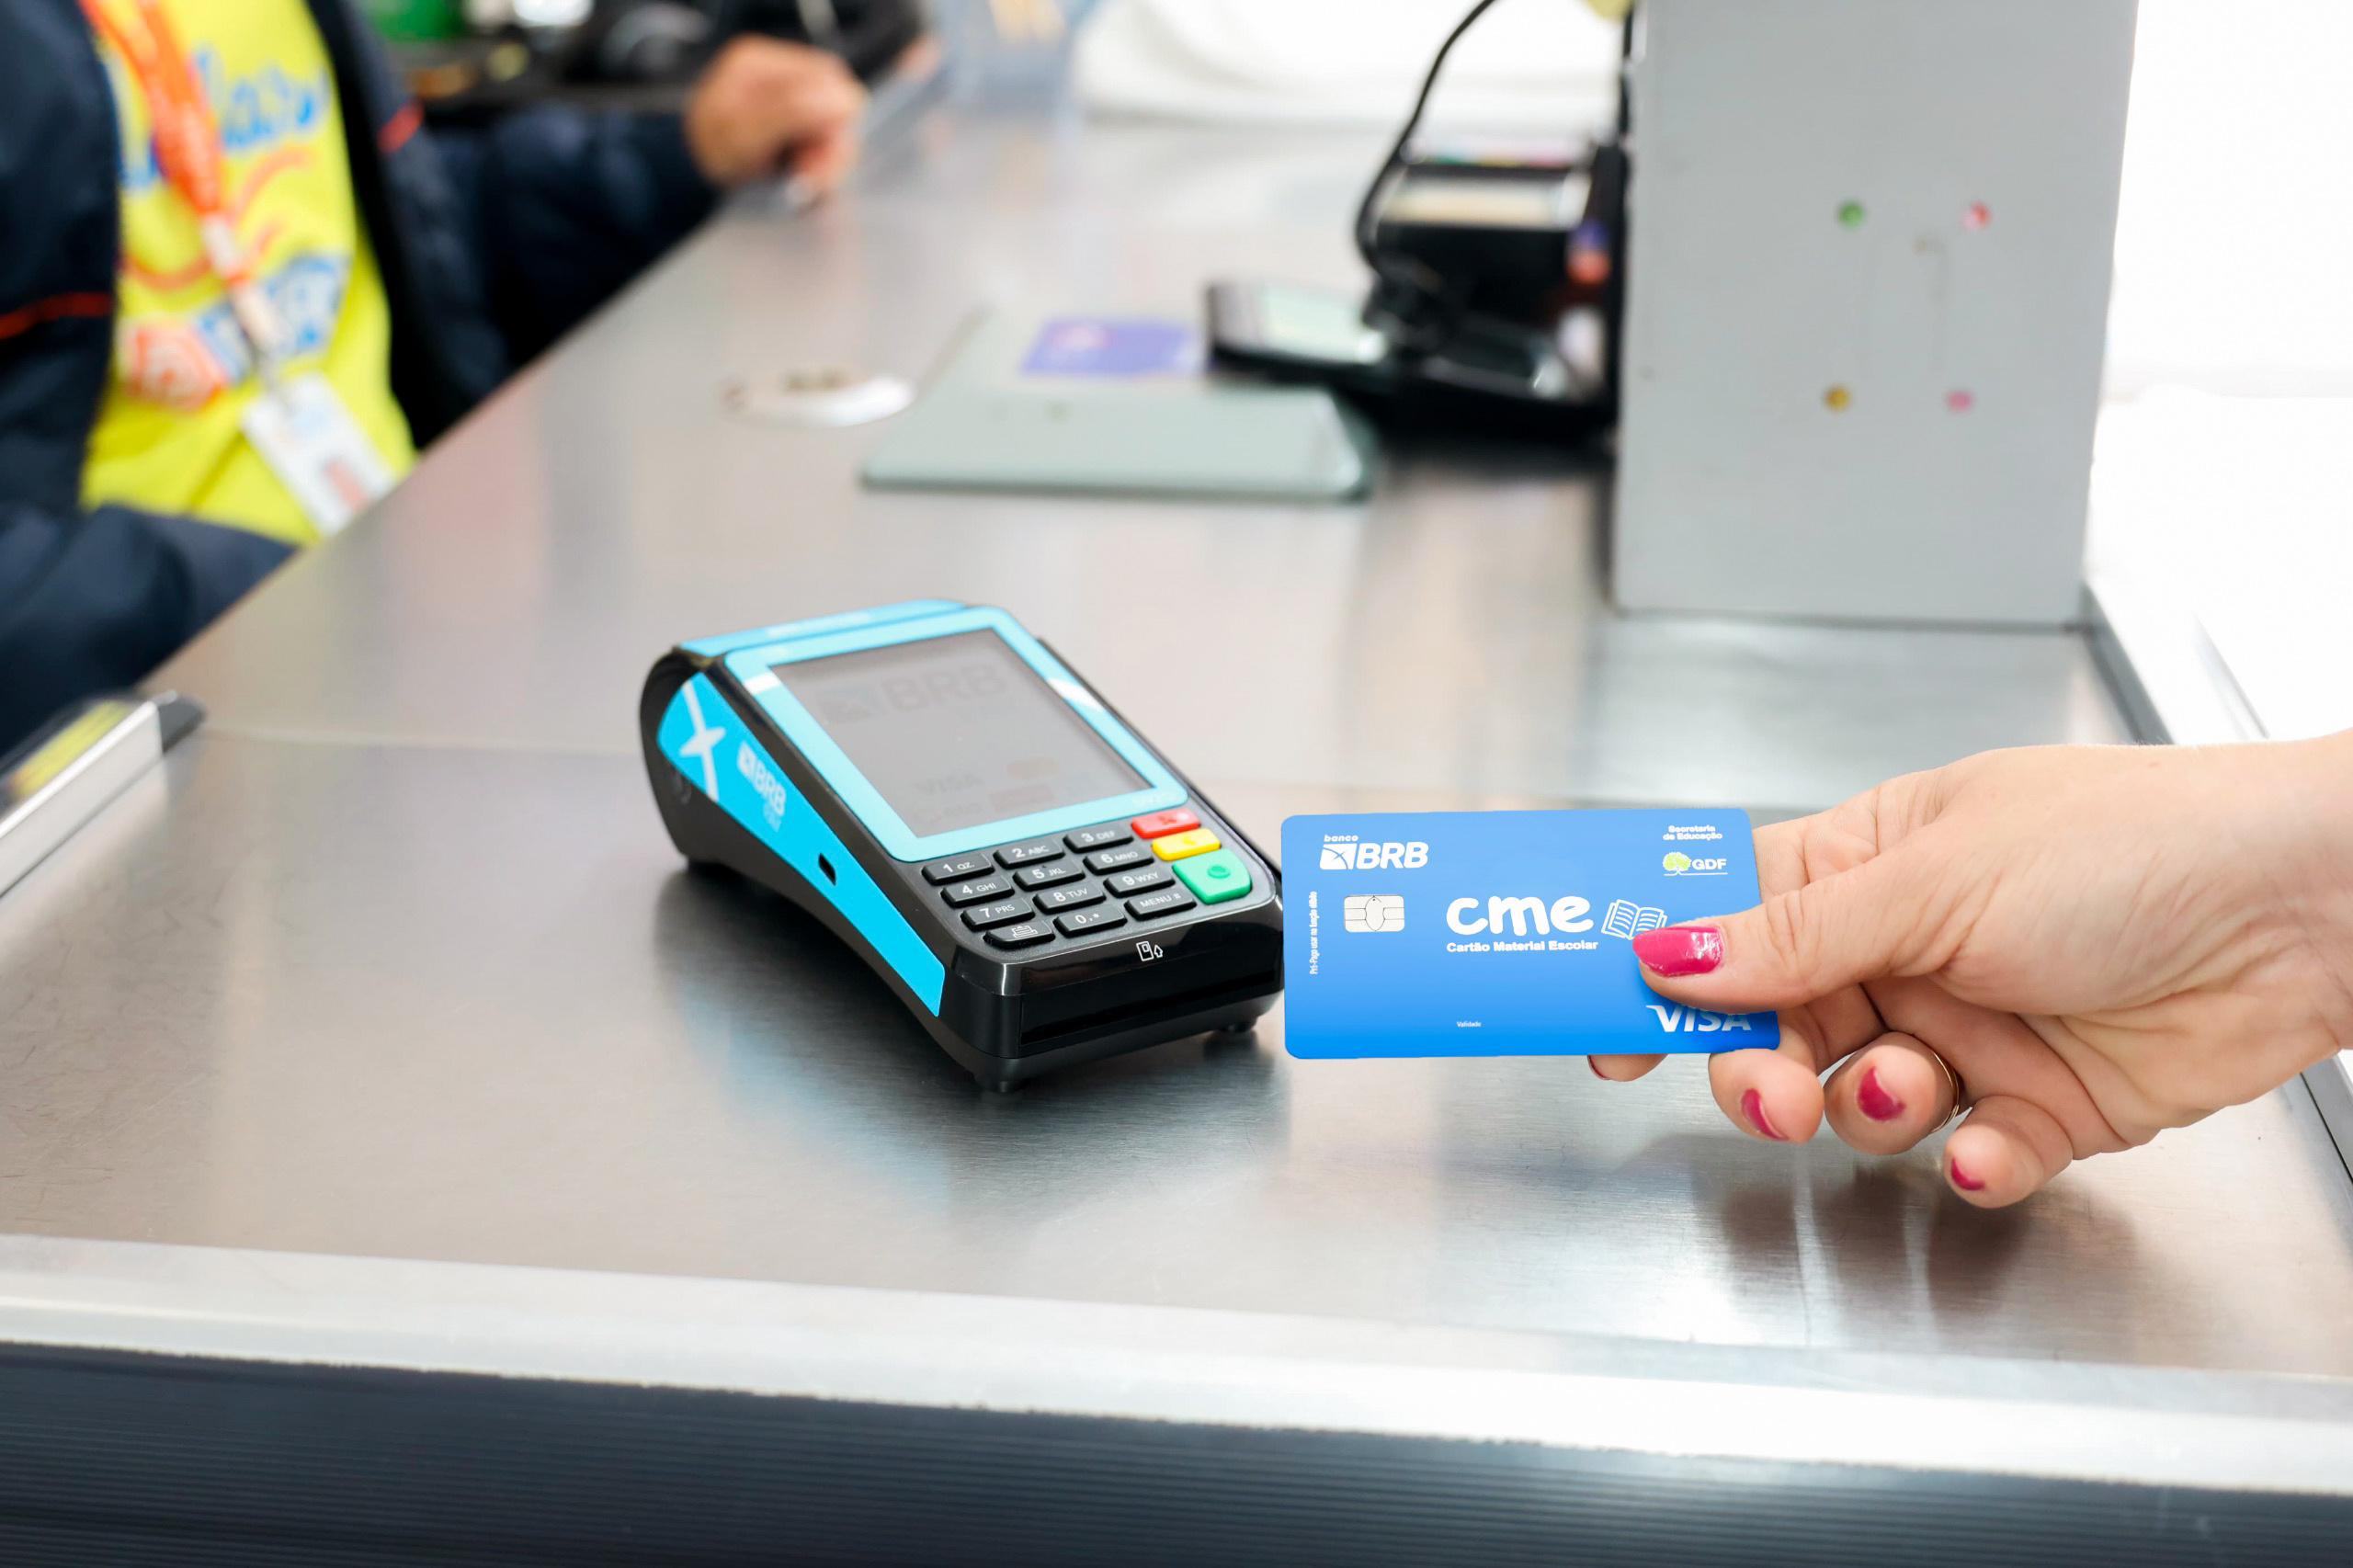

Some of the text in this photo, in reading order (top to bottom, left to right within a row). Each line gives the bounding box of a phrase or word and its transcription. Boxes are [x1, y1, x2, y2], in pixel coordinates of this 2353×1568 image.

[880, 665, 1007, 711] BRB
[754, 759, 787, 817] BRB
[914, 773, 984, 797] VISA
[1668, 824, 1716, 833] Secretaria
[1081, 831, 1115, 842] 3 DEF
[1677, 832, 1722, 841] Educação
[1012, 846, 1049, 858] 2 ABC
[1100, 851, 1138, 863] 6 MNO
[1356, 842, 1429, 869] BRB
[943, 864, 953, 872] 1
[1692, 858, 1727, 870] GDF
[1032, 868, 1066, 879] 5 JKL
[1122, 872, 1158, 885] 9 WXY
[962, 883, 996, 894] 4 GHI
[1053, 888, 1087, 902] 8 TUV
[1140, 895, 1172, 907] MENU
[980, 904, 1015, 917] 7 PRS
[1446, 896, 1594, 936] cme
[1447, 940, 1598, 952] Cartão Material Escolar
[1645, 1005, 1752, 1033] VISA
